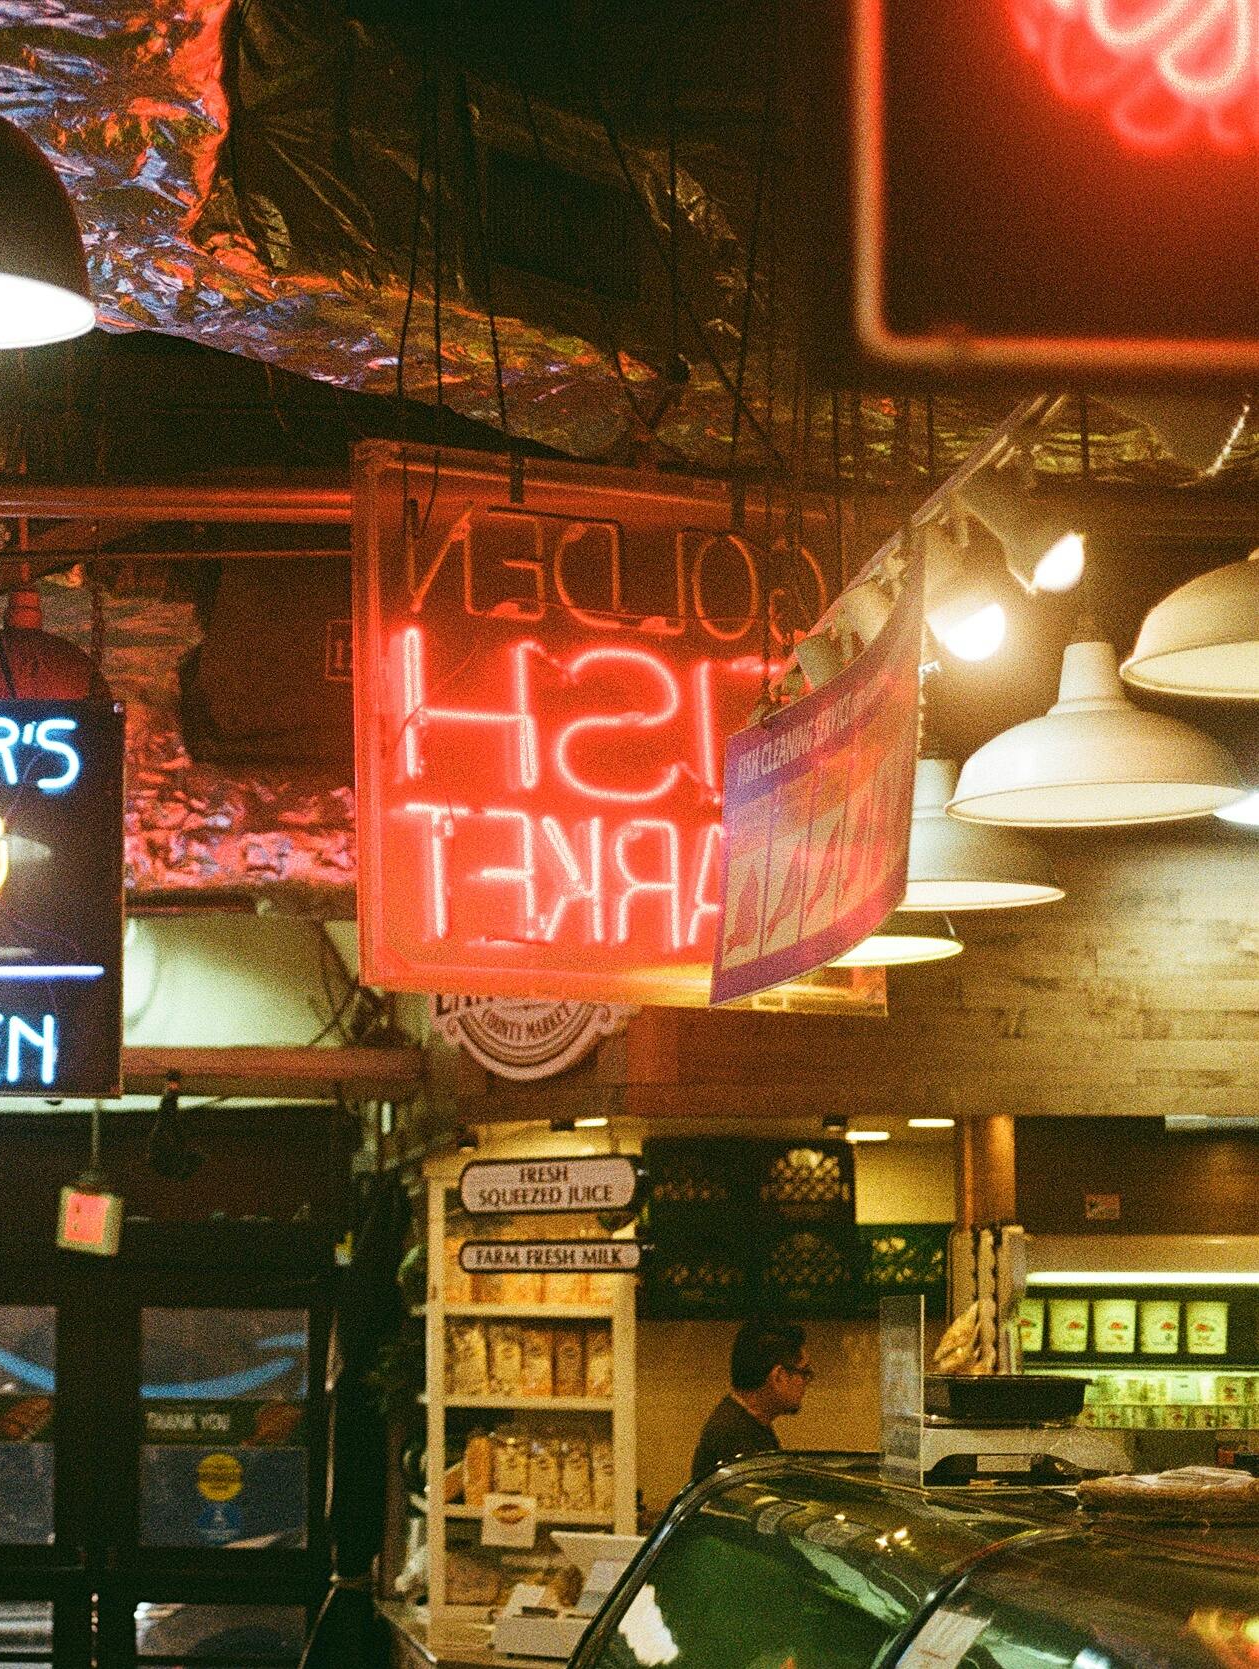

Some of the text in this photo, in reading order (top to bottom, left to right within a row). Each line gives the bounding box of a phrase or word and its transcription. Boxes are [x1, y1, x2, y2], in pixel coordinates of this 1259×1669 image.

[519, 1165, 569, 1183] FRESH
[478, 1184, 613, 1206] SQUEEZED JUICE
[475, 1248, 621, 1265] FARM FRESH MILK
[145, 1411, 231, 1431] THANK YOU
